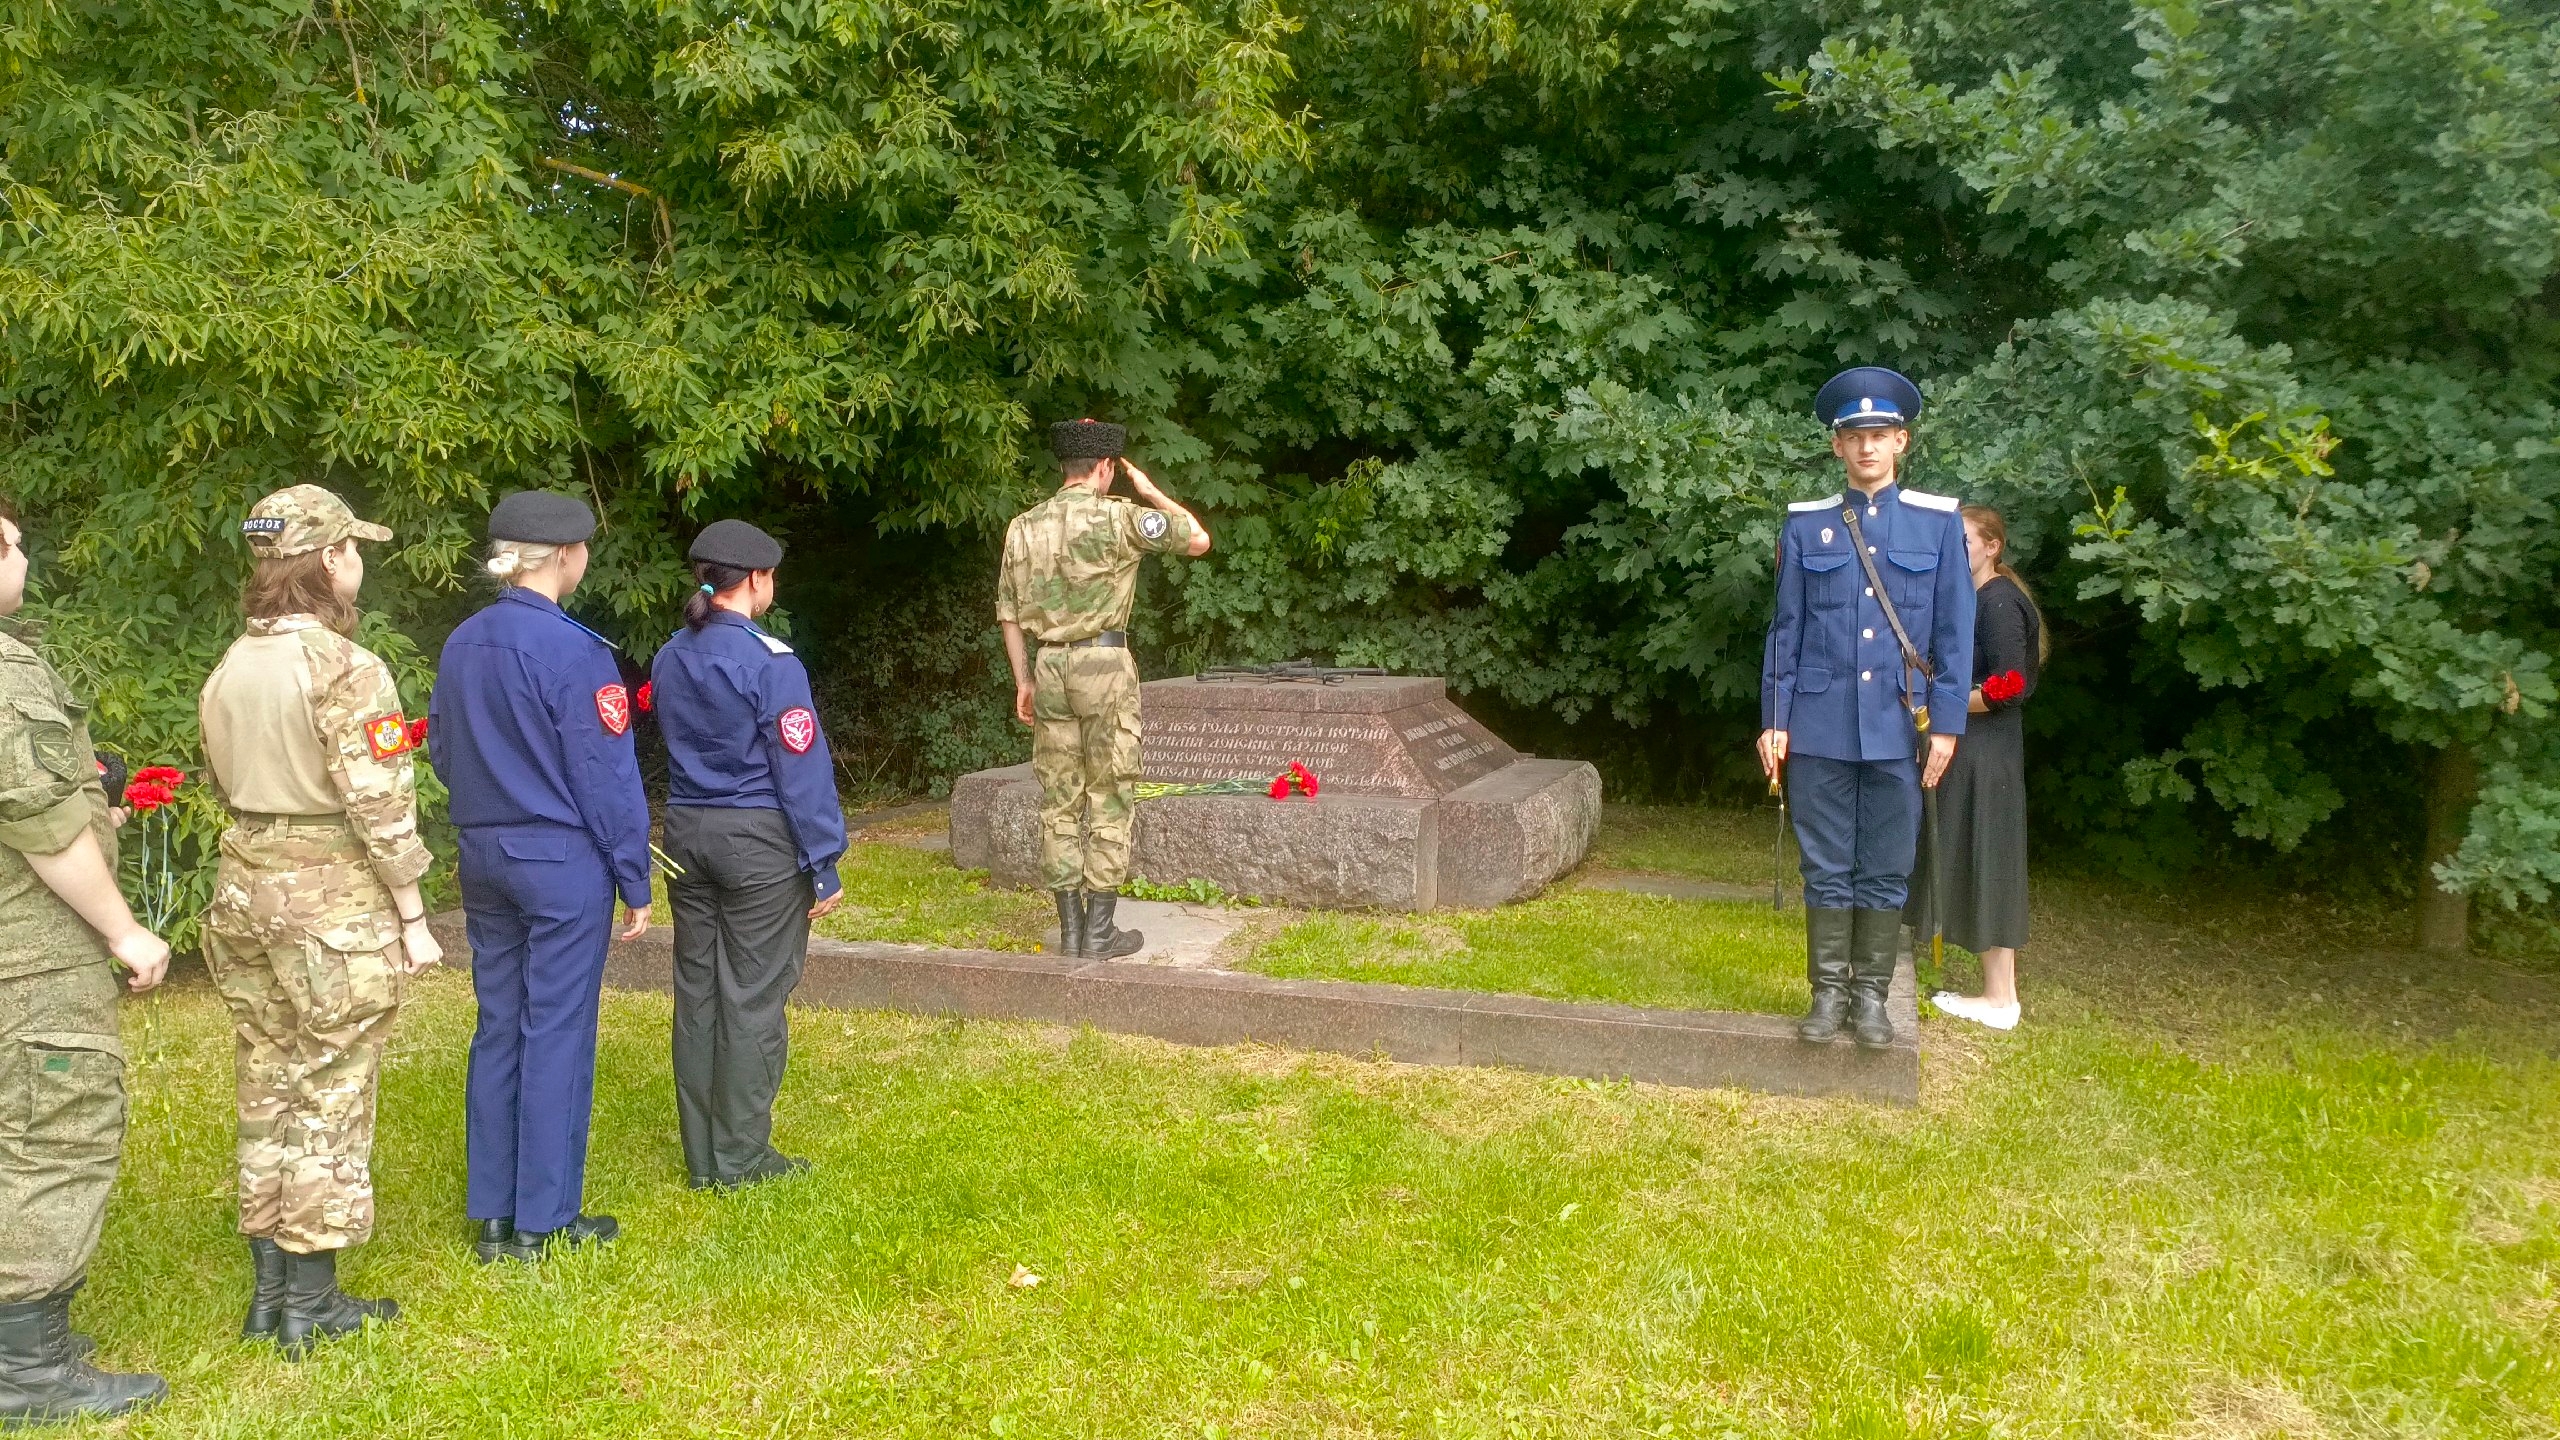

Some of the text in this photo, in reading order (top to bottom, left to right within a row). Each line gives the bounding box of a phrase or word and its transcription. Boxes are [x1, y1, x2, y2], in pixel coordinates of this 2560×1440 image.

[243, 519, 281, 530] ВОСТОК
[1167, 721, 1198, 734] 1656
[1201, 721, 1240, 735] ГОДА
[1256, 723, 1323, 738] ОСТРОВА
[1141, 735, 1349, 754] ОТИЛИЯ ДОНСКИХ КАЗАКОВ
[1143, 750, 1335, 769] МОСКОВСКИХ СТРЕЦОВ
